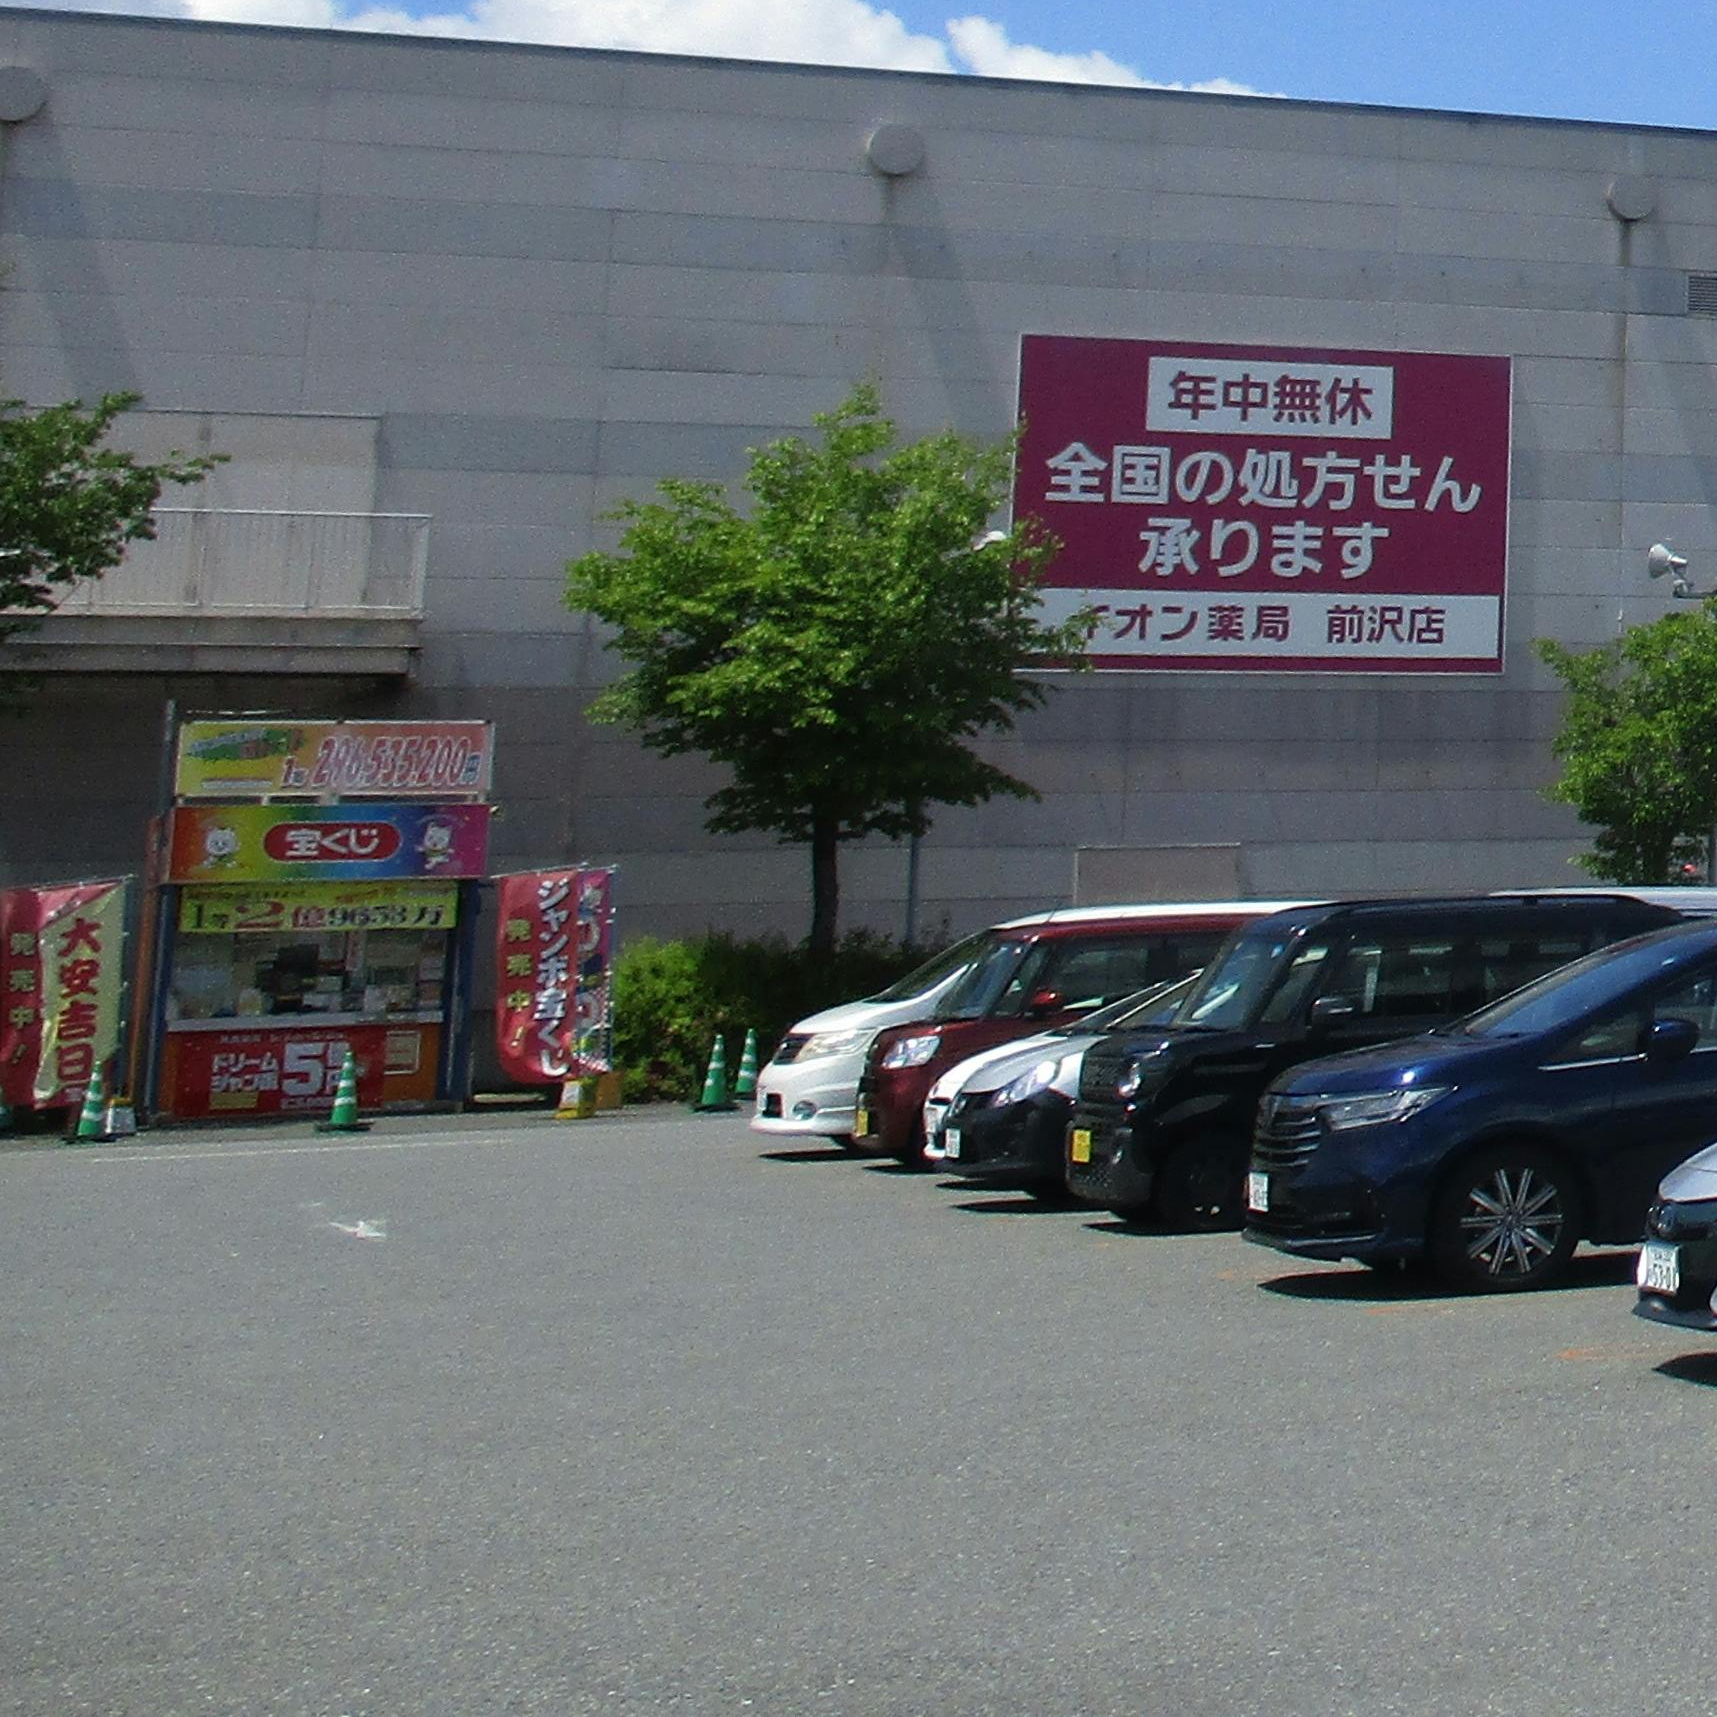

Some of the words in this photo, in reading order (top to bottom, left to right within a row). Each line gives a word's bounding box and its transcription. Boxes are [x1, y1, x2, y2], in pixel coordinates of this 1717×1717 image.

[1167, 370, 1374, 426] 年中無休
[1044, 441, 1483, 514] 全国の処方せん
[1138, 517, 1391, 580] 承ります
[1326, 604, 1447, 645] 前沢店
[285, 828, 380, 858] 宝くじ
[57, 917, 103, 1083] 大安吉日
[533, 877, 571, 1077] ジャンボ宝くじ
